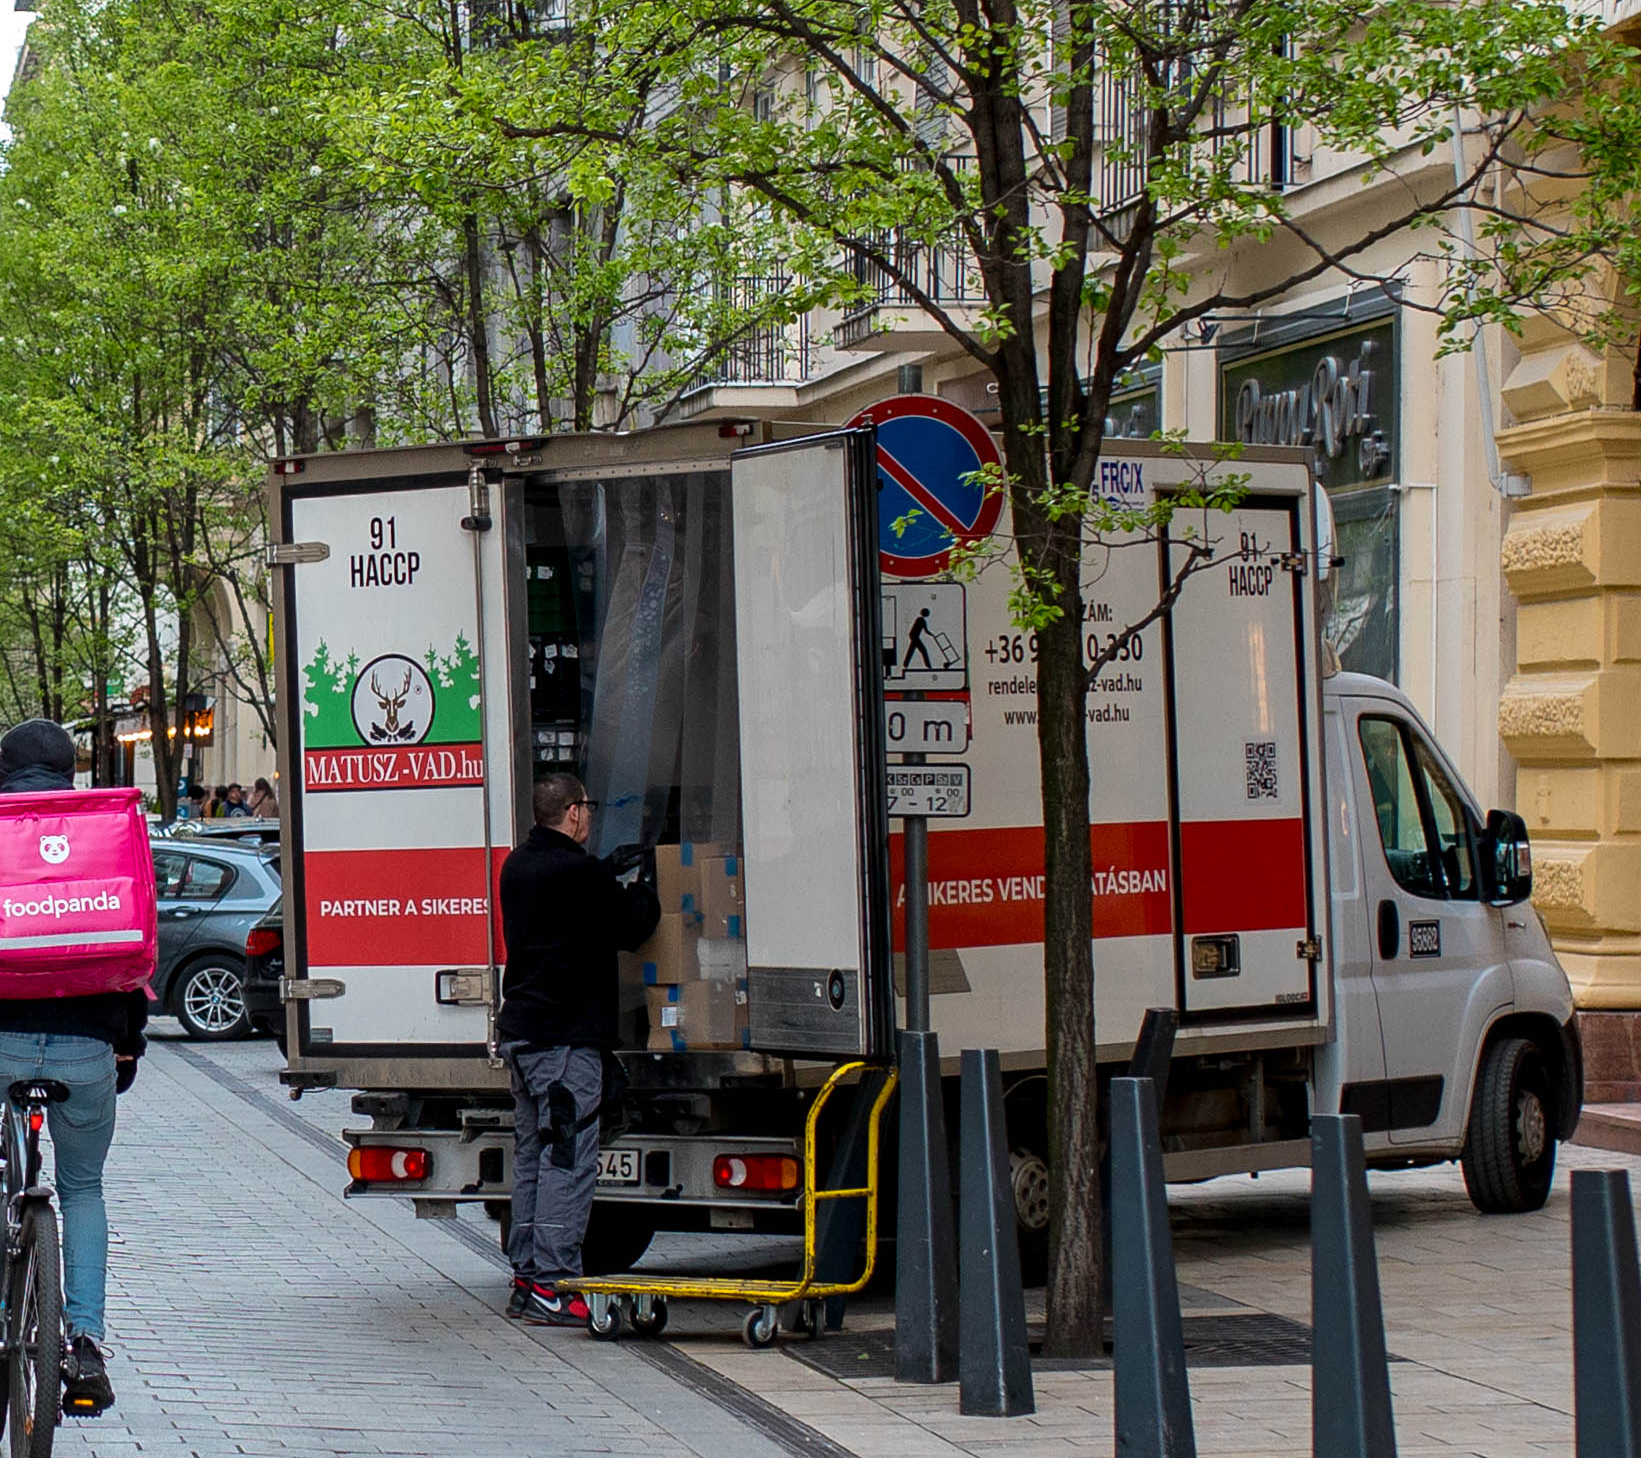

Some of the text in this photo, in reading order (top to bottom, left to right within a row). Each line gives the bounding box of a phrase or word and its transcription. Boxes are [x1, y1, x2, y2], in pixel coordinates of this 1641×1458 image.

[370, 516, 397, 550] 91
[1240, 532, 1258, 562] 91
[350, 552, 420, 588] HACCP
[1228, 565, 1272, 596] HACCP
[984, 635, 1024, 664] +36
[888, 712, 952, 742] 0 m
[925, 774, 934, 784] P
[952, 774, 961, 785] V
[926, 796, 948, 812] 12
[2, 891, 121, 919] foodpanda
[928, 878, 994, 906] IKERES
[320, 898, 401, 918] PARTNER
[404, 898, 418, 916] A
